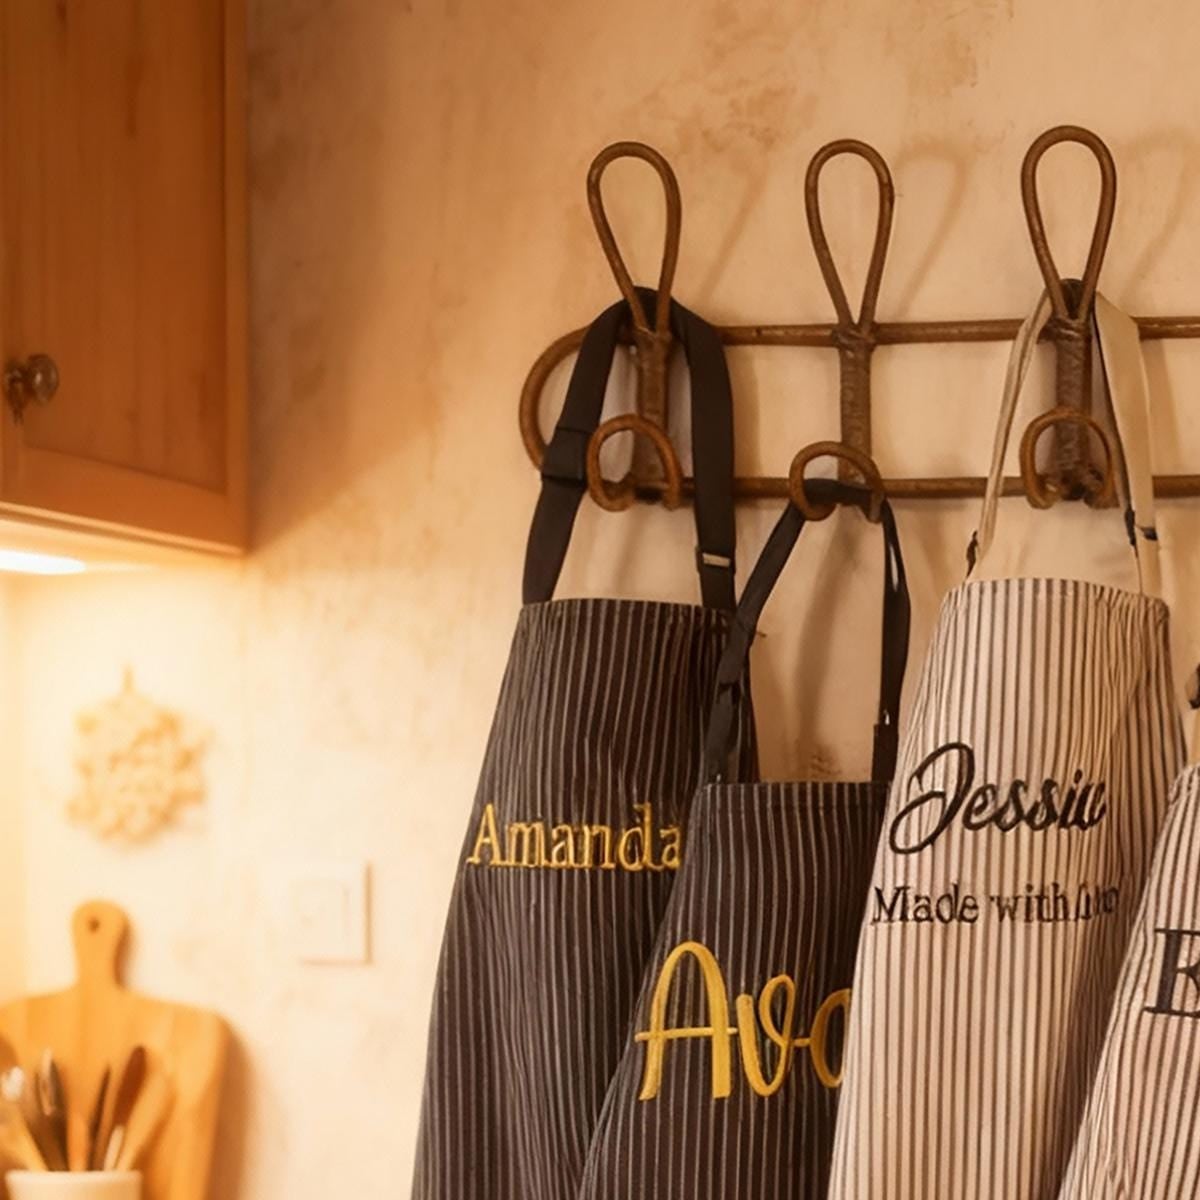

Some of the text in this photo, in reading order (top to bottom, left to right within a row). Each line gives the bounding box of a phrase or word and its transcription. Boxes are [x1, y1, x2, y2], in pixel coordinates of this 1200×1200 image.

[465, 803, 681, 872] Amanda
[869, 883, 980, 926] Made
[989, 883, 1071, 923] with
